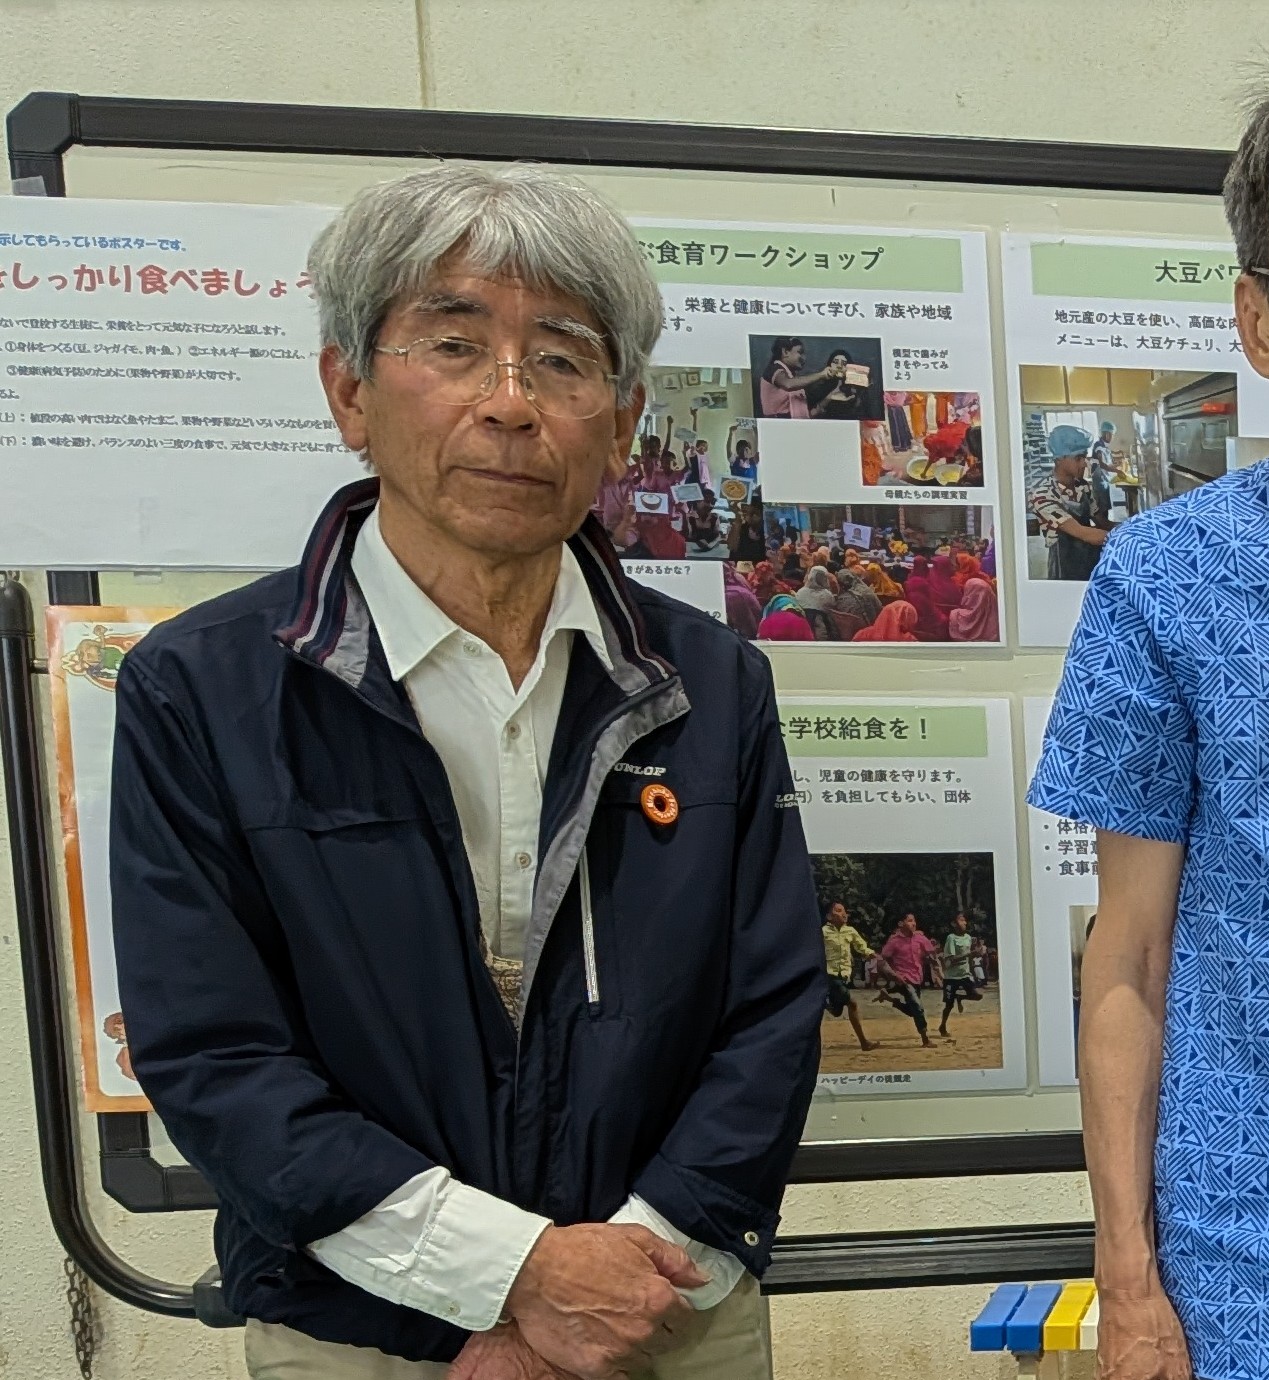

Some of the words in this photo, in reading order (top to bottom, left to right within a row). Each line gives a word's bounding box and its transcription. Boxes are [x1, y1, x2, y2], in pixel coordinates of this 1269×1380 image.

[0, 261, 313, 299] しっかり食べましょ
[661, 296, 953, 321] 、栄養と健康について学び、家族や地域
[1056, 334, 1244, 353] メニューは、大豆ケチュリ、大
[894, 371, 911, 380] よう
[612, 762, 667, 777] UNLOP
[1057, 818, 1096, 835] 体格
